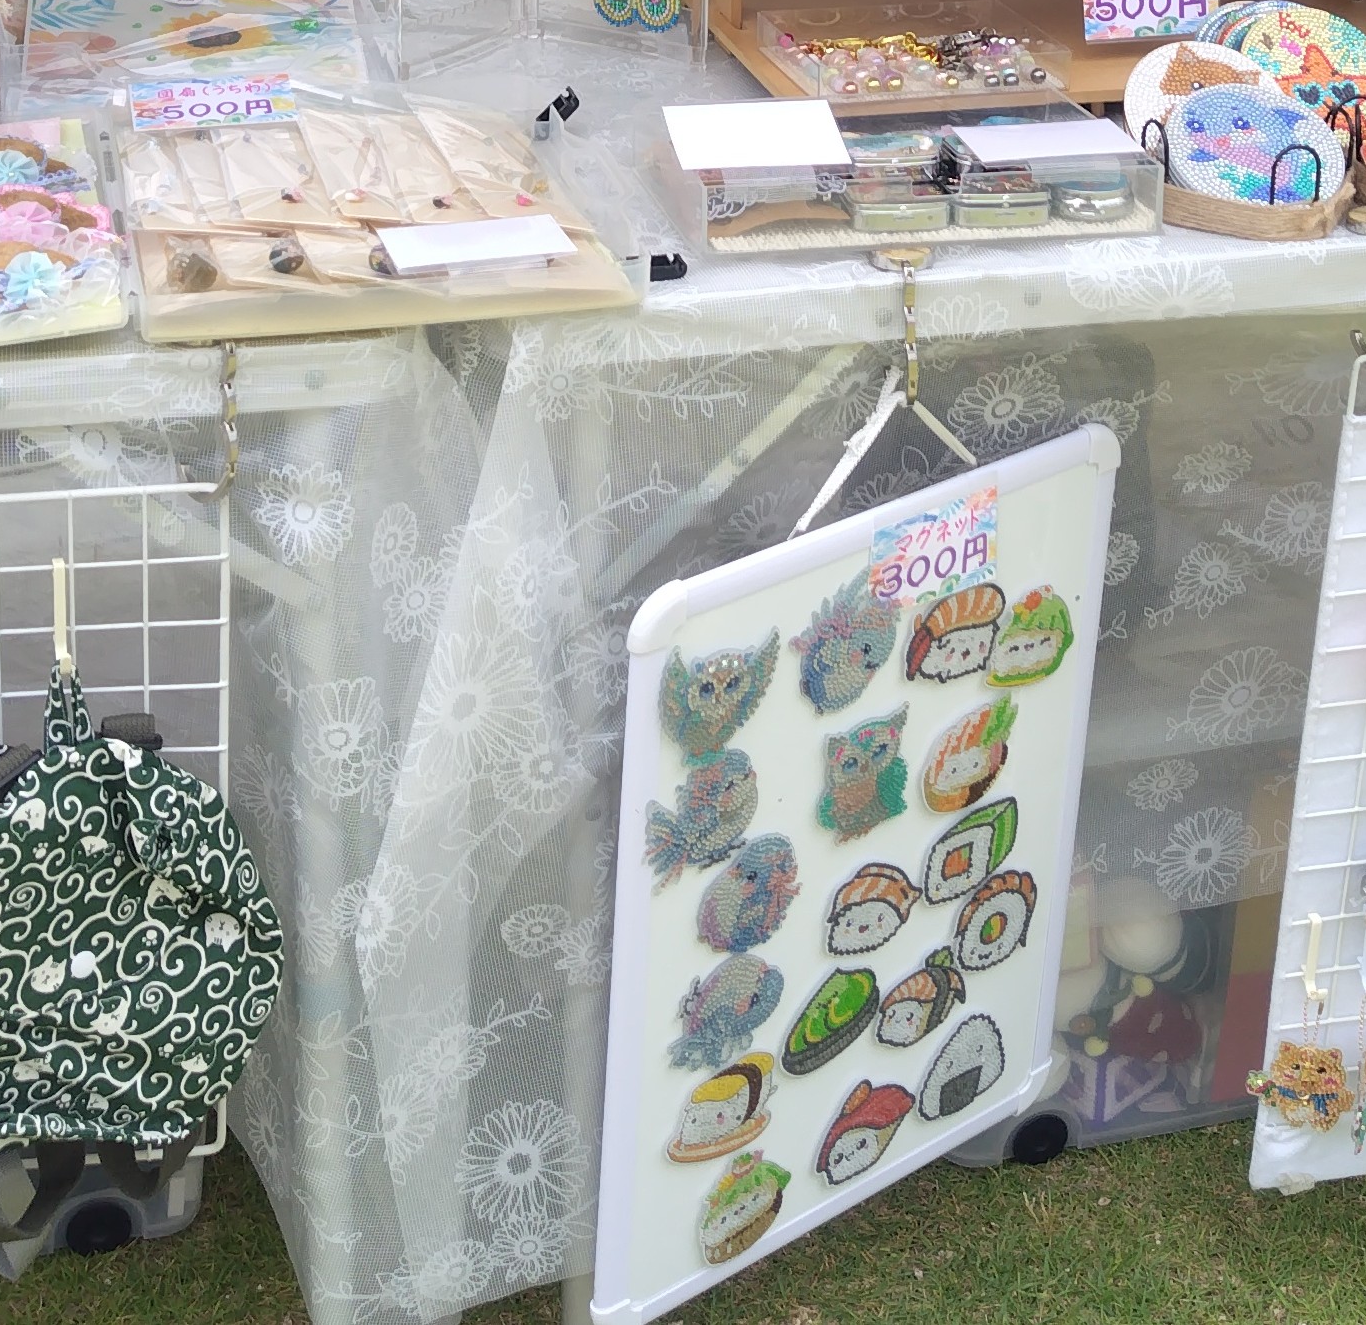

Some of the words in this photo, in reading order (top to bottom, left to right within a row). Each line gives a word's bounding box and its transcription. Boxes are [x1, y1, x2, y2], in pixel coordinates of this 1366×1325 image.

[163, 99, 272, 119] 500円
[895, 507, 979, 552] マグネット
[879, 532, 987, 597] 300円
